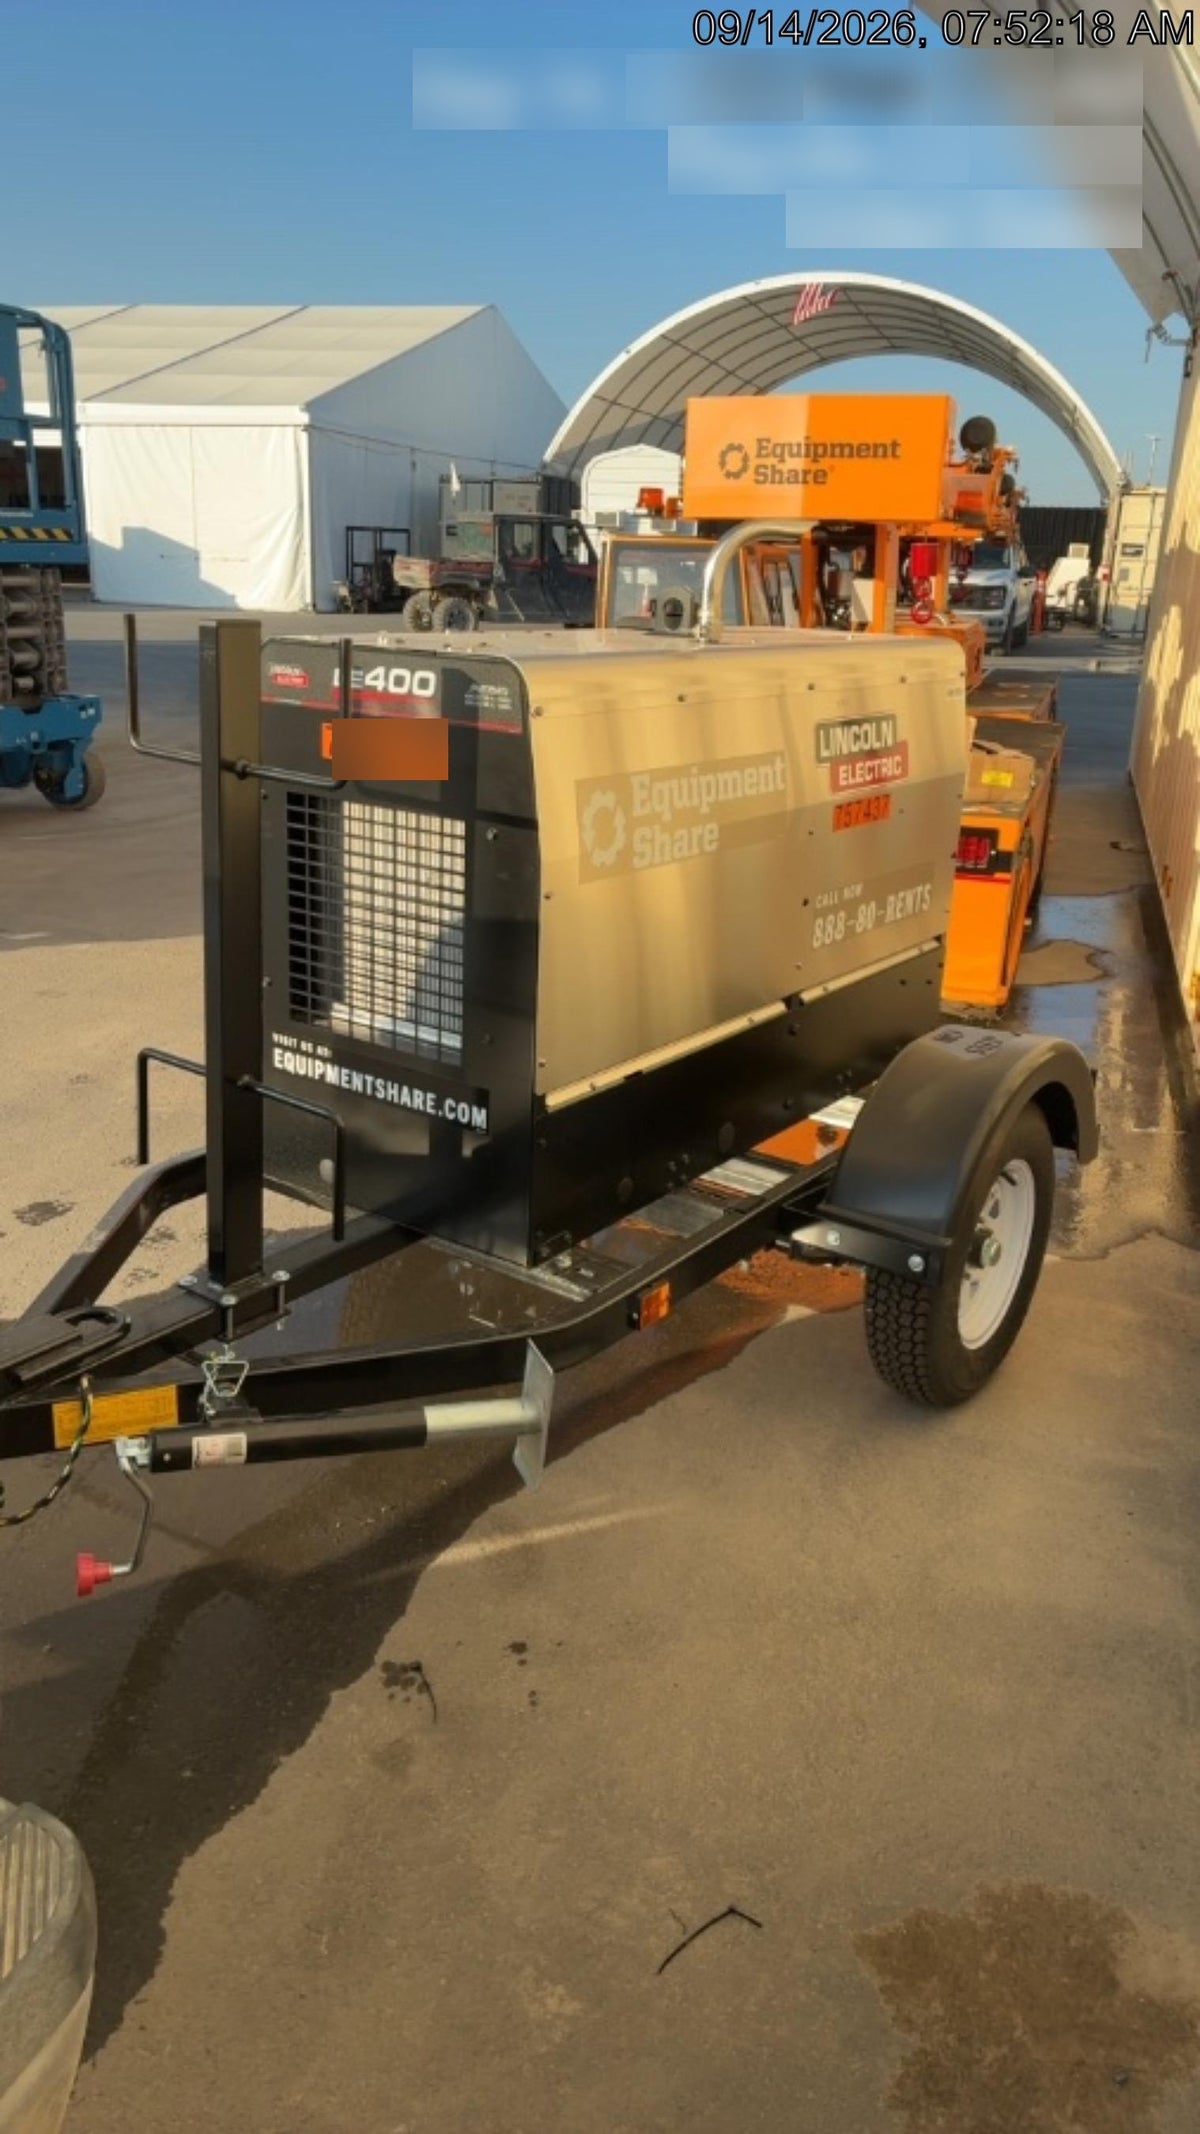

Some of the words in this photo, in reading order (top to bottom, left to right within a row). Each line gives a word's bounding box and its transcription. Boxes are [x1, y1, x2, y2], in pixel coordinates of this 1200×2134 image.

[755, 436, 900, 462] Equipment
[754, 463, 828, 485] Share
[820, 720, 893, 757] LINCOLN
[630, 756, 786, 821] Equipment
[839, 756, 901, 785] ELECTRIC
[632, 822, 719, 869] Share
[812, 883, 932, 949] 888-80-RENTS
[272, 1047, 488, 1130] EQUIPMENTSHARE.COM
